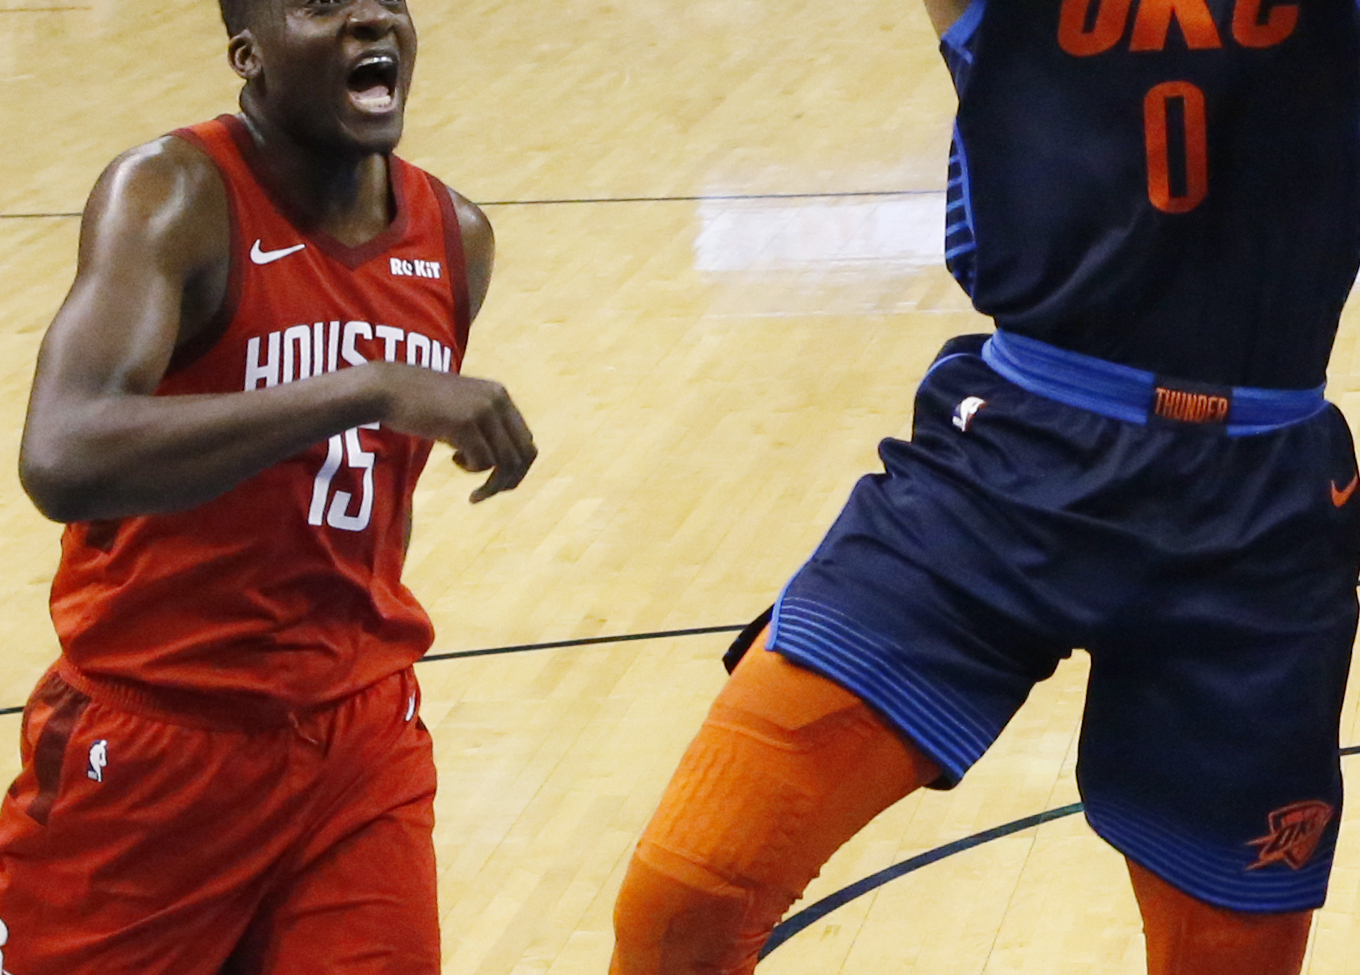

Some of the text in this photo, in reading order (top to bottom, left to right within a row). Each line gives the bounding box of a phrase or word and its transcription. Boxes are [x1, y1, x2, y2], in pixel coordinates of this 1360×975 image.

[1143, 80, 1209, 214] 0
[1154, 386, 1229, 423] THUNDER
[308, 420, 381, 532] 15
